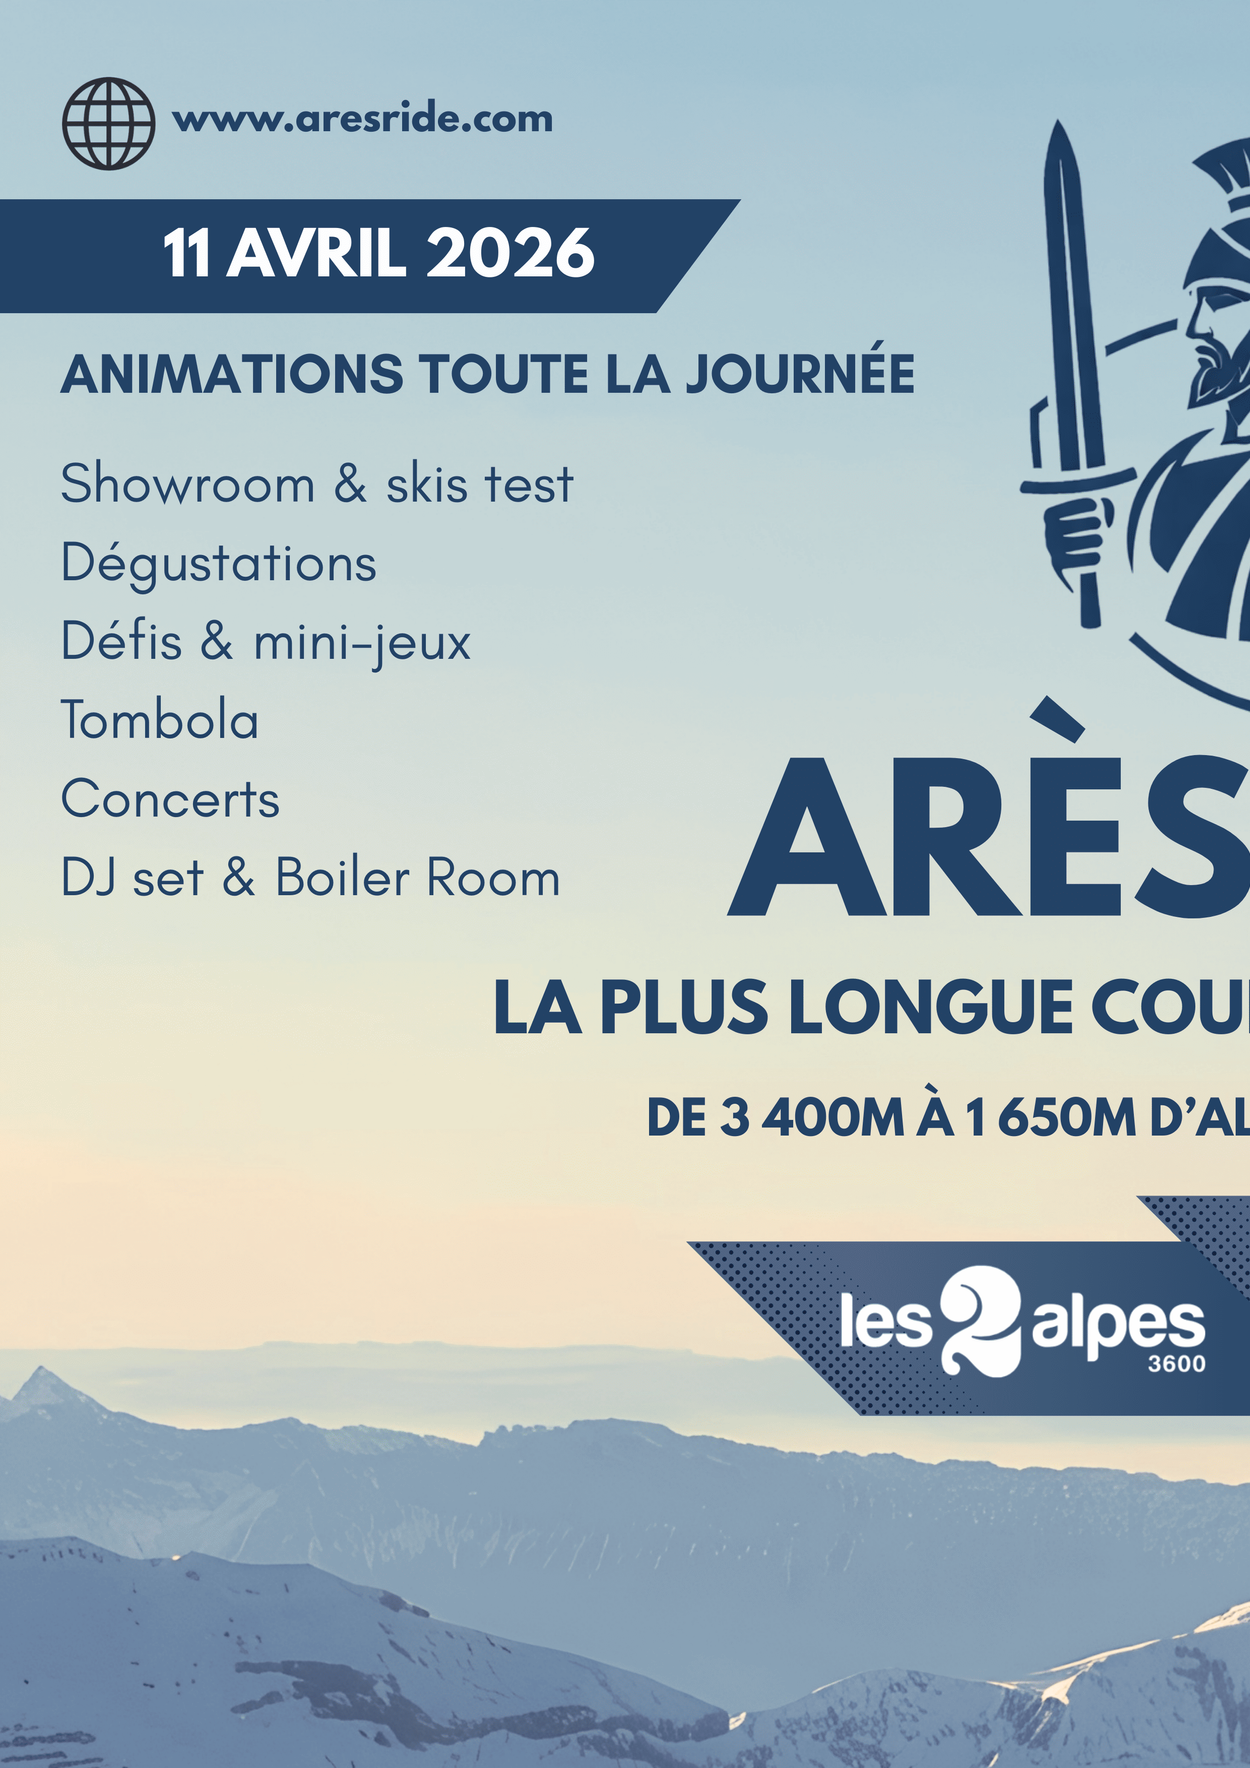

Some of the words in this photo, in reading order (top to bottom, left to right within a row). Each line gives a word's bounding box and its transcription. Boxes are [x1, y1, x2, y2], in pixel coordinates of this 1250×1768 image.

[172, 99, 552, 132] www.aresride.com
[165, 228, 208, 276] 11
[226, 228, 406, 276] AVRIL
[427, 227, 594, 277] 2026
[60, 354, 403, 394] ANIMATIONS
[419, 354, 587, 393] TOUTE
[608, 354, 671, 393] LA
[687, 340, 914, 393] JOURNÉE
[62, 459, 313, 504] Showroom
[335, 462, 366, 502] &
[388, 459, 467, 502] skis
[485, 467, 574, 502] test
[64, 541, 376, 594] Dégustations
[64, 616, 181, 660] Défis
[201, 620, 233, 660] &
[256, 624, 470, 673] mini-jeux
[61, 695, 257, 739] Tombola
[62, 777, 279, 817] Concerts
[64, 856, 114, 896] DJ
[134, 860, 204, 896] set
[223, 856, 255, 896] &
[278, 852, 409, 896] Boiler
[429, 856, 558, 896] Room
[496, 979, 582, 1033] LA
[602, 979, 768, 1034] PLUS
[791, 978, 1072, 1034] LONGUE
[649, 1097, 705, 1136] DE
[721, 1097, 749, 1136] 3
[762, 1097, 904, 1136] 400M
[916, 1083, 955, 1136] À
[967, 1097, 982, 1136] 1
[999, 1097, 1136, 1136] 650M
[1149, 1355, 1205, 1372] 3600
